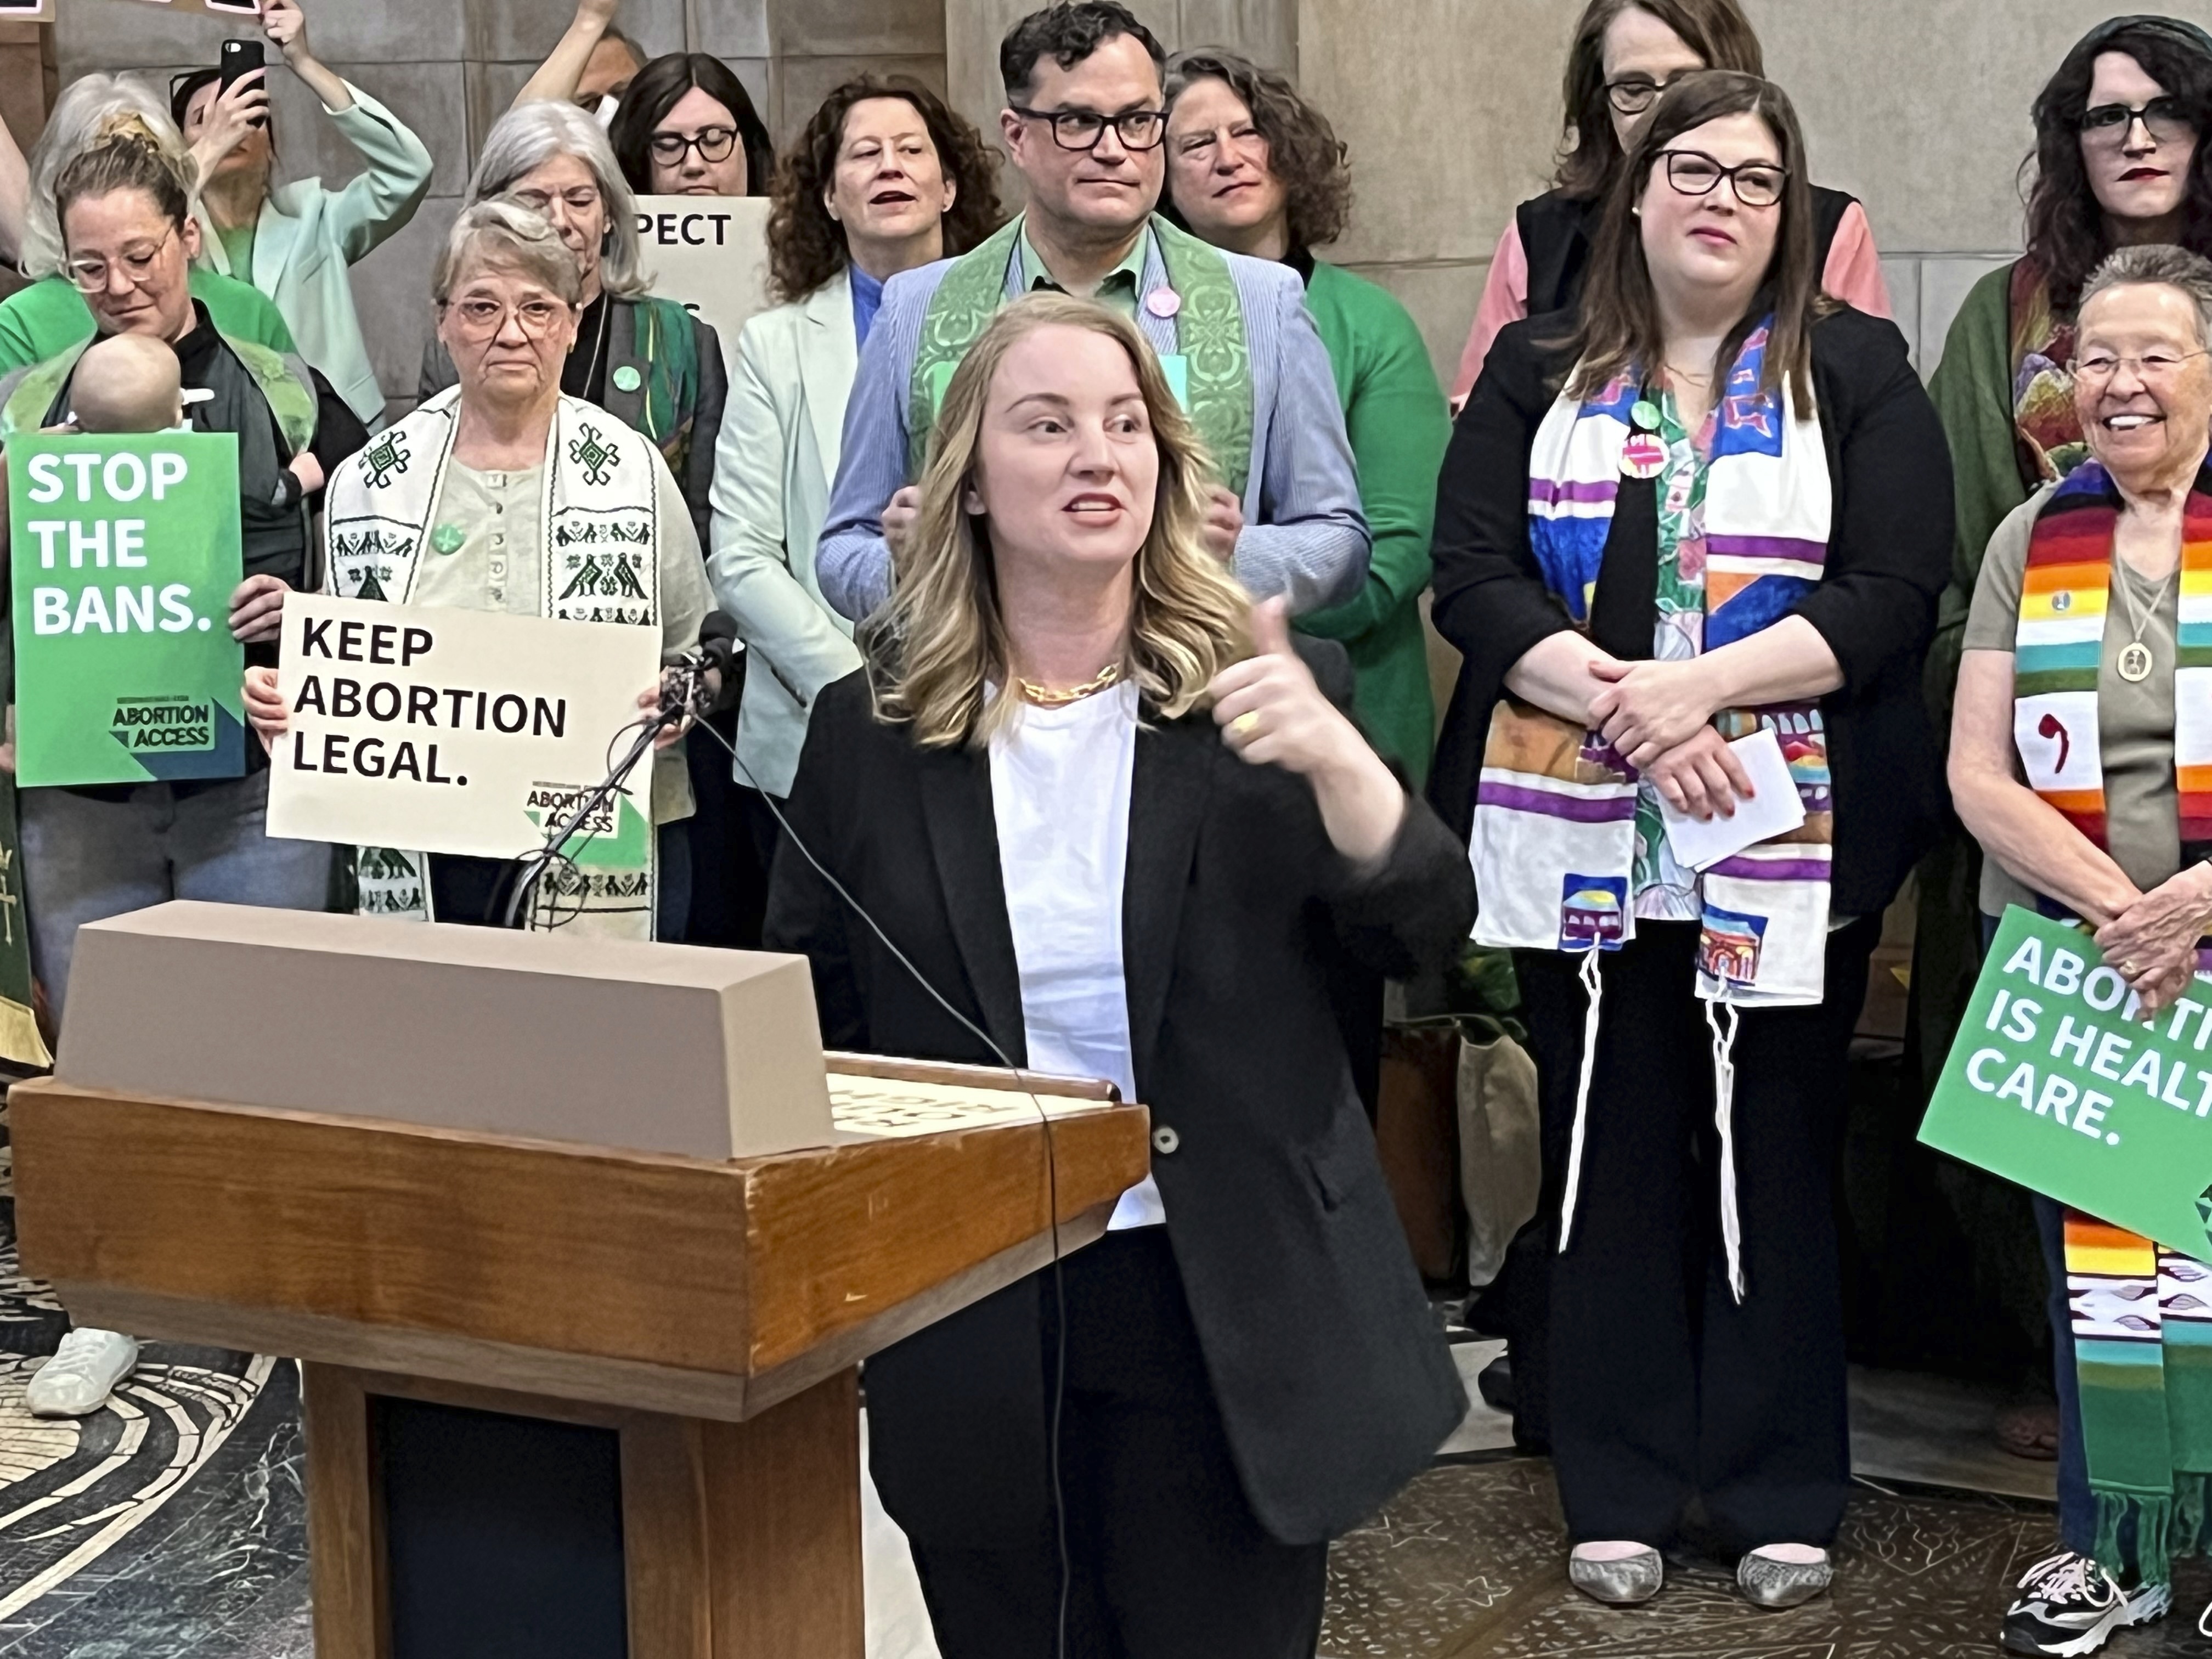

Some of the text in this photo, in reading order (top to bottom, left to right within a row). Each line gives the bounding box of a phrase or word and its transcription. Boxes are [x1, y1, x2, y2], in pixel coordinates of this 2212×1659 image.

[28, 452, 188, 503] STOP
[27, 519, 148, 568] THE
[33, 584, 211, 635] BANS.
[302, 617, 433, 667] KEEP
[112, 704, 209, 726] ABORTION
[294, 675, 566, 738] ABORTION
[133, 726, 210, 748] ACCESS
[294, 731, 468, 787] LEGAL.
[1986, 989, 2212, 1118] IS HEALT
[1966, 1048, 2120, 1146] CARE.
